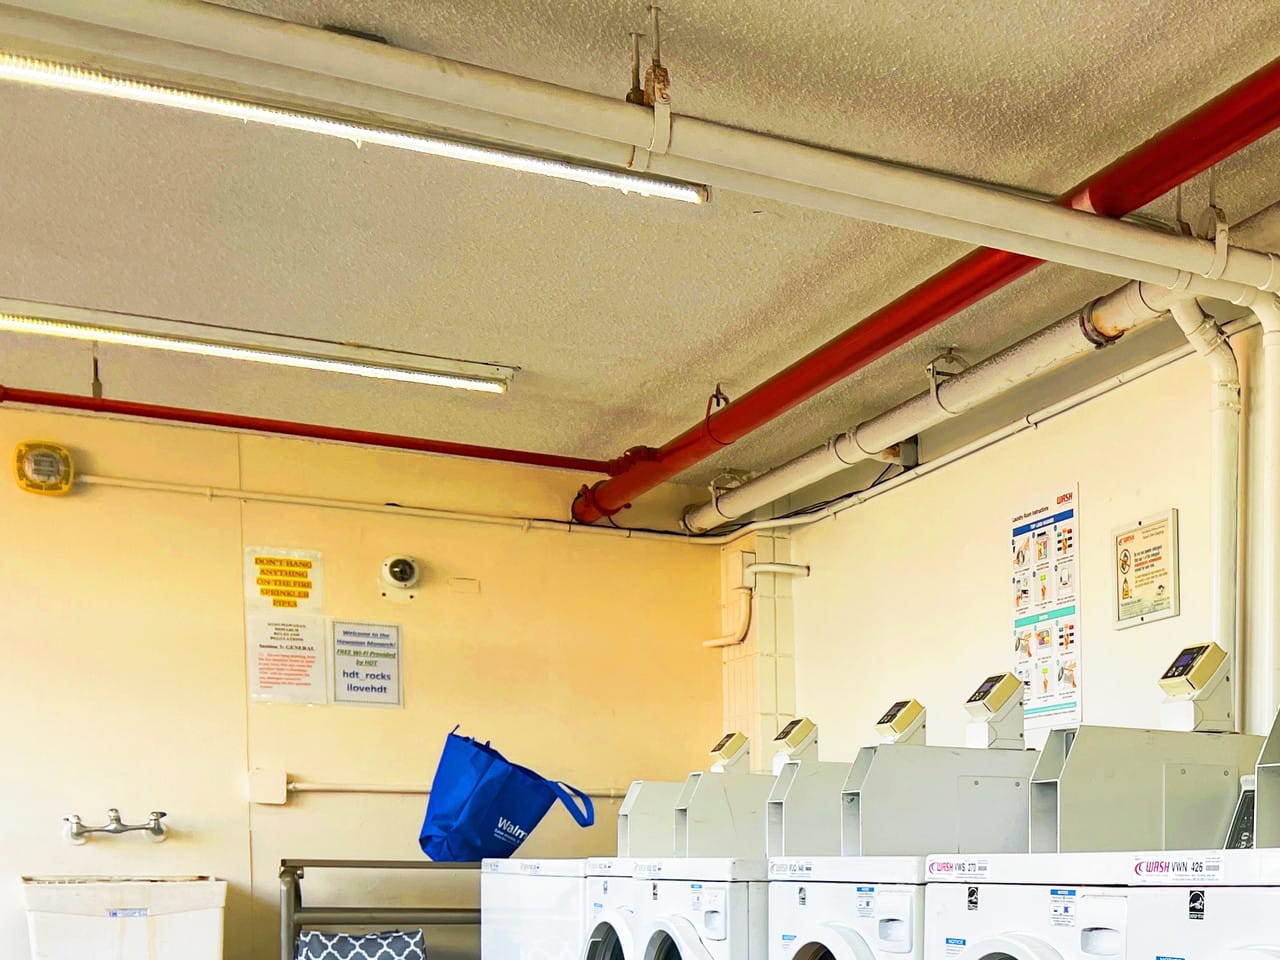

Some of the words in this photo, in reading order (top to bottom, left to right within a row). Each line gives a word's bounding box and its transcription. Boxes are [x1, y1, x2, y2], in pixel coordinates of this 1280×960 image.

[255, 557, 282, 566] DON'T
[286, 559, 312, 569] HANG
[260, 569, 308, 579] ANYTHING
[293, 580, 312, 589] FIRE
[260, 588, 309, 598] SPRINKLER
[342, 669, 391, 681] hdt_rocks
[347, 683, 387, 693] ilovehdt
[936, 862, 954, 872] WASH
[1145, 861, 1170, 873] WASH
[1191, 861, 1204, 872] 426
